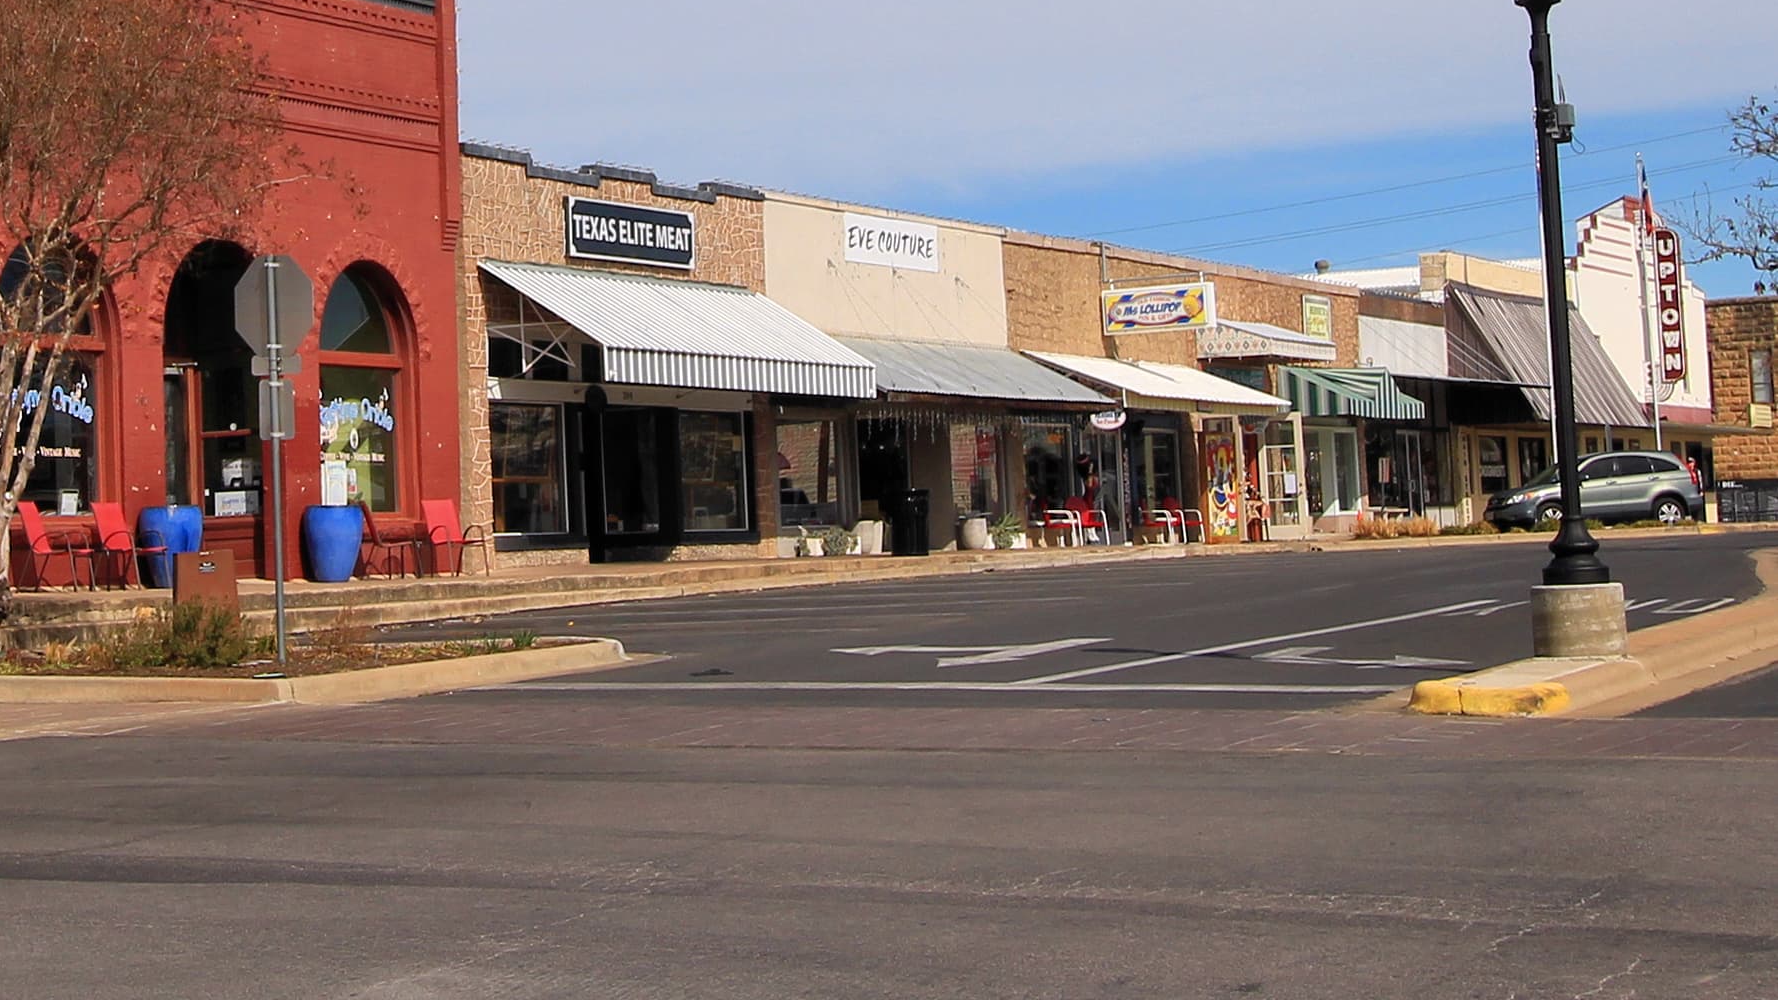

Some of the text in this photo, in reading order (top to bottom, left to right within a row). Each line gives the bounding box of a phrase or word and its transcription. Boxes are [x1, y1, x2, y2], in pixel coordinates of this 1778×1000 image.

[572, 213, 691, 252] TEXAS ELITE MEAT
[848, 225, 934, 258] EVE COUTURE
[1140, 302, 1181, 314] LOLLIPOP
[1657, 239, 1681, 371] UPTOWN
